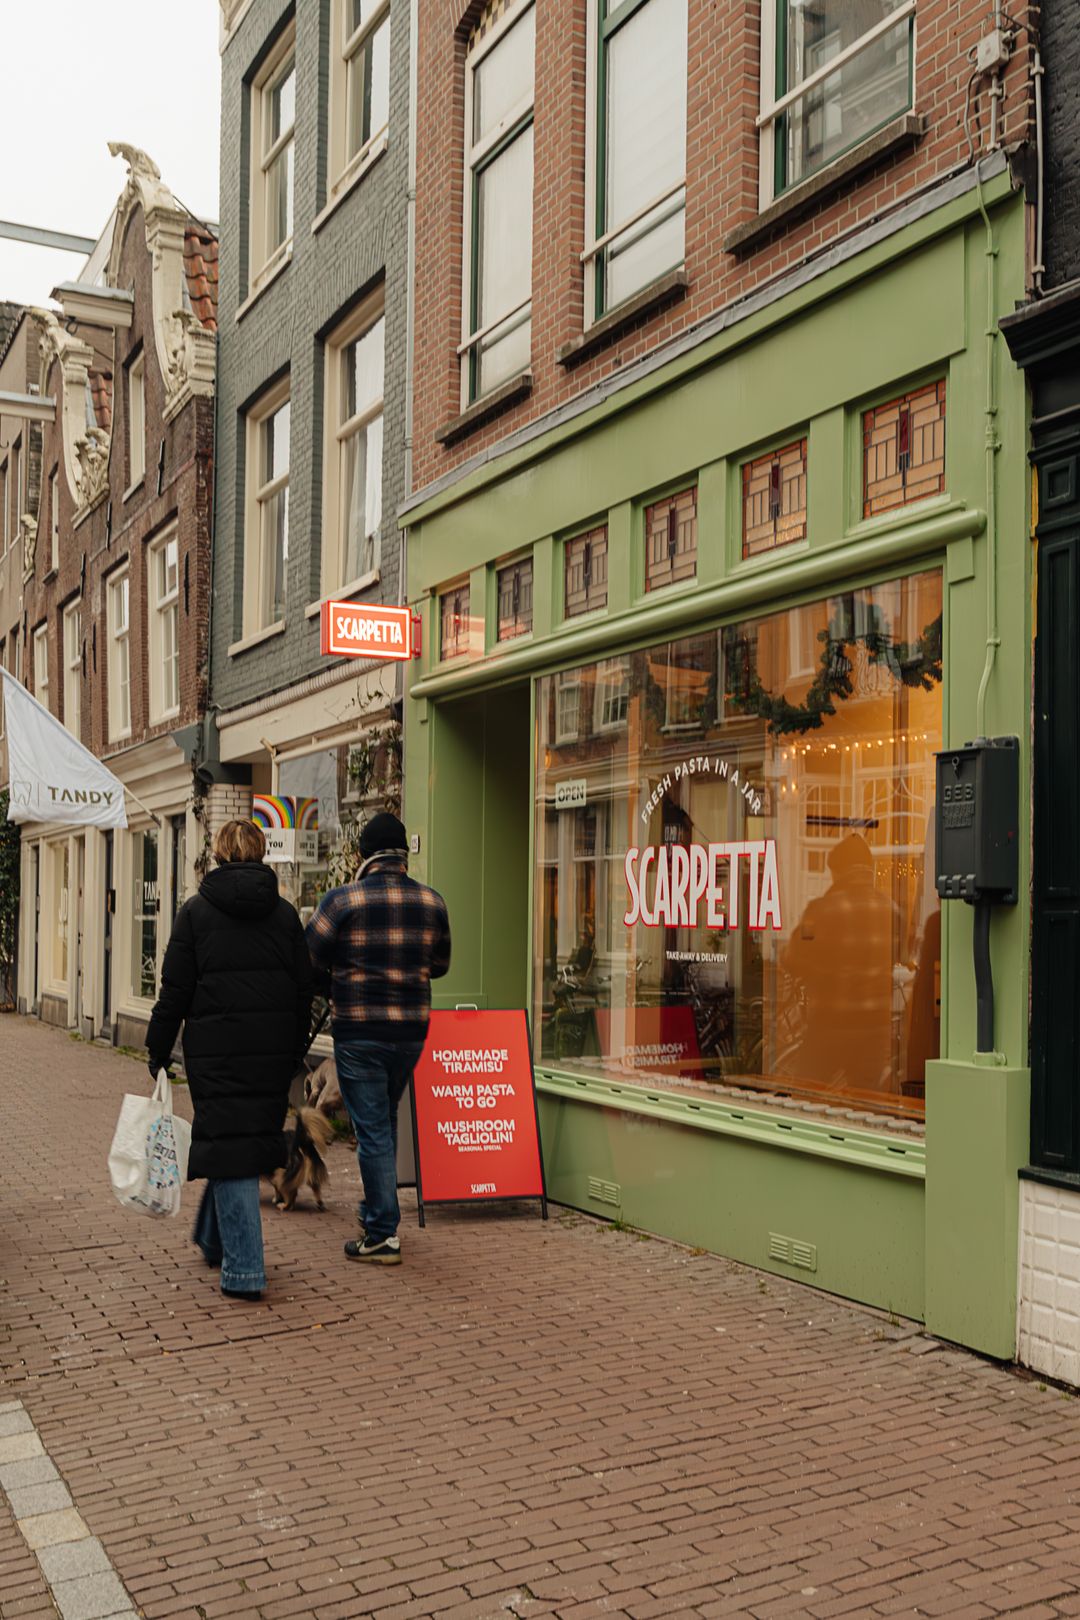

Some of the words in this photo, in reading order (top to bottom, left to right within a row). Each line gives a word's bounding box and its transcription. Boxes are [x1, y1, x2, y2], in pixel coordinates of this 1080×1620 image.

[336, 616, 403, 644] SCARPETTA
[47, 786, 113, 805] TANDY
[558, 785, 584, 802] OPEN
[641, 774, 672, 824] FRESH
[674, 756, 710, 781] PASTA
[714, 758, 728, 777] IN
[731, 769, 739, 787] A
[741, 781, 761, 815] JAR
[268, 840, 284, 848] YOU
[624, 839, 782, 930] SCARPETTA
[701, 952, 728, 964] DELIVERY
[432, 1049, 509, 1061] HOMEMADE
[431, 1085, 474, 1097] WARM
[476, 1084, 516, 1096] PASTA
[455, 1096, 474, 1109] TO
[477, 1096, 497, 1108] GO
[437, 1119, 515, 1133] MUSHROOM
[444, 1131, 514, 1145] TAGLIOLINI
